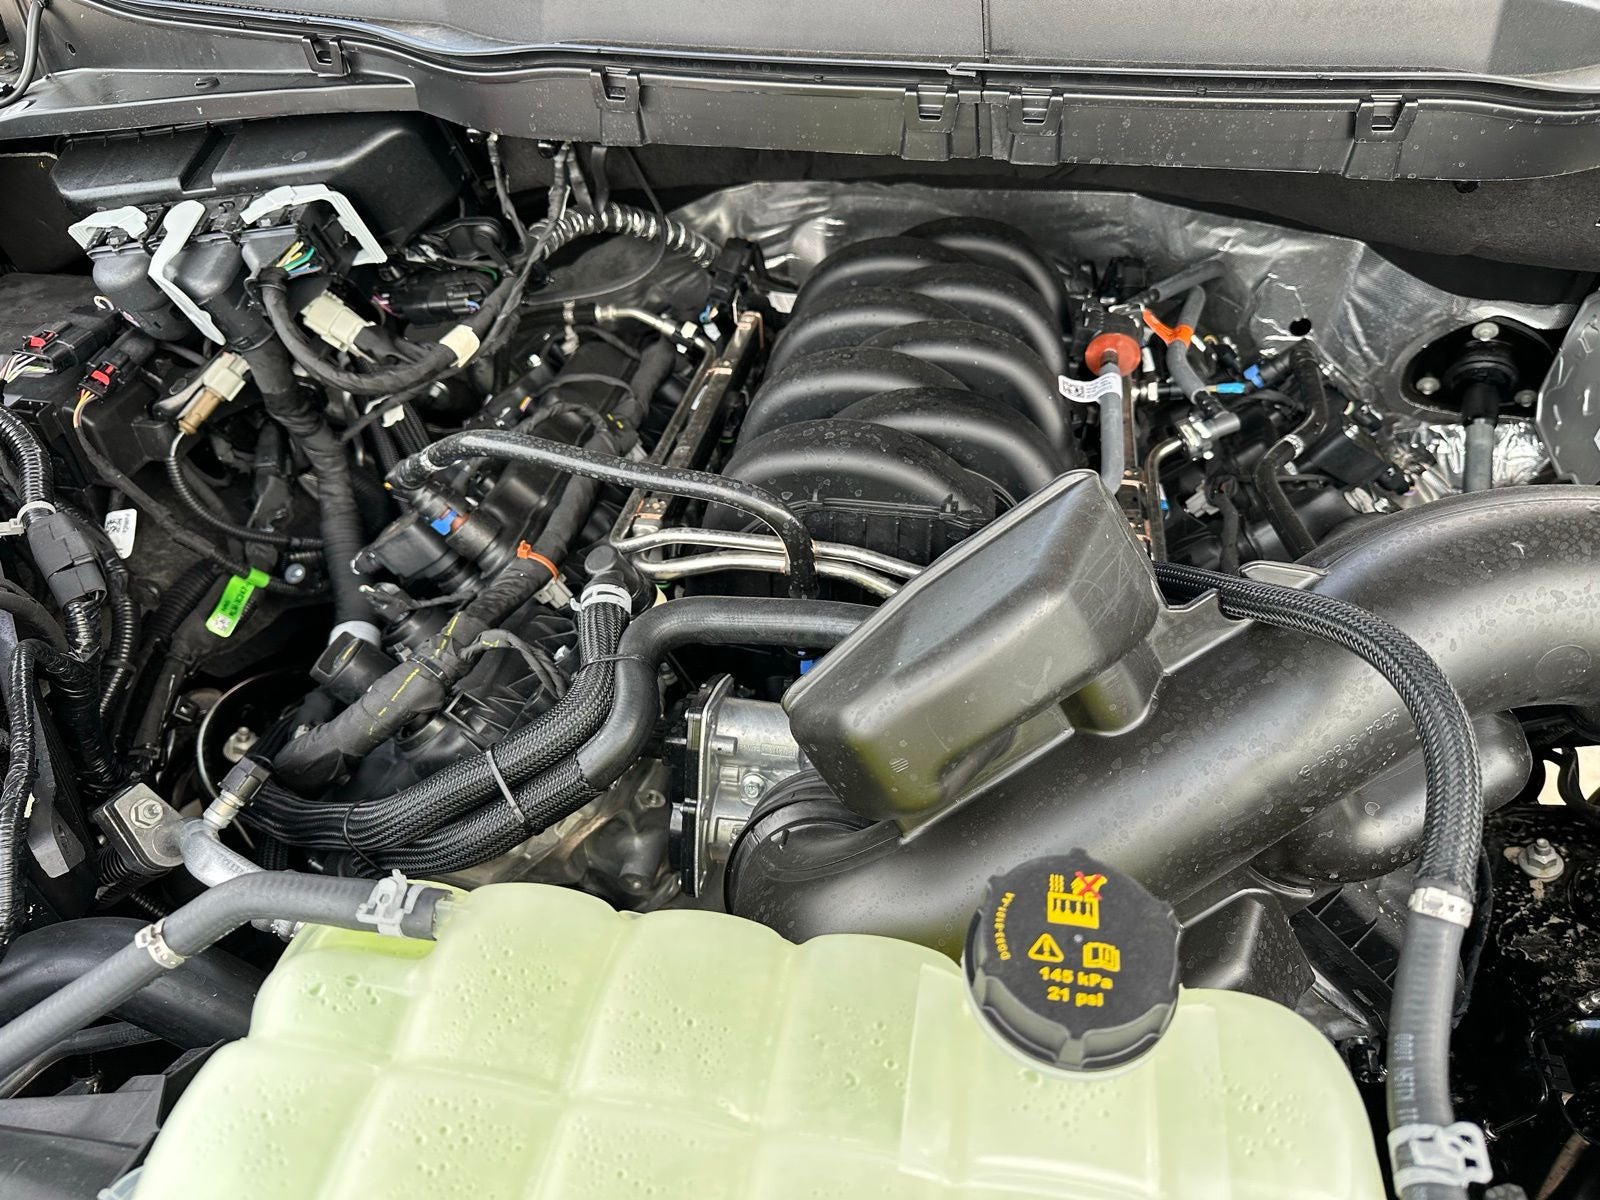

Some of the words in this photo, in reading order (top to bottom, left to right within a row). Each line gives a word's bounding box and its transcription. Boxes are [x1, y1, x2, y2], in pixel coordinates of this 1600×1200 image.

[1039, 966, 1074, 985] 145
[1076, 971, 1113, 990] kPa
[1047, 986, 1070, 1003] 21
[1075, 991, 1104, 1008] psi
